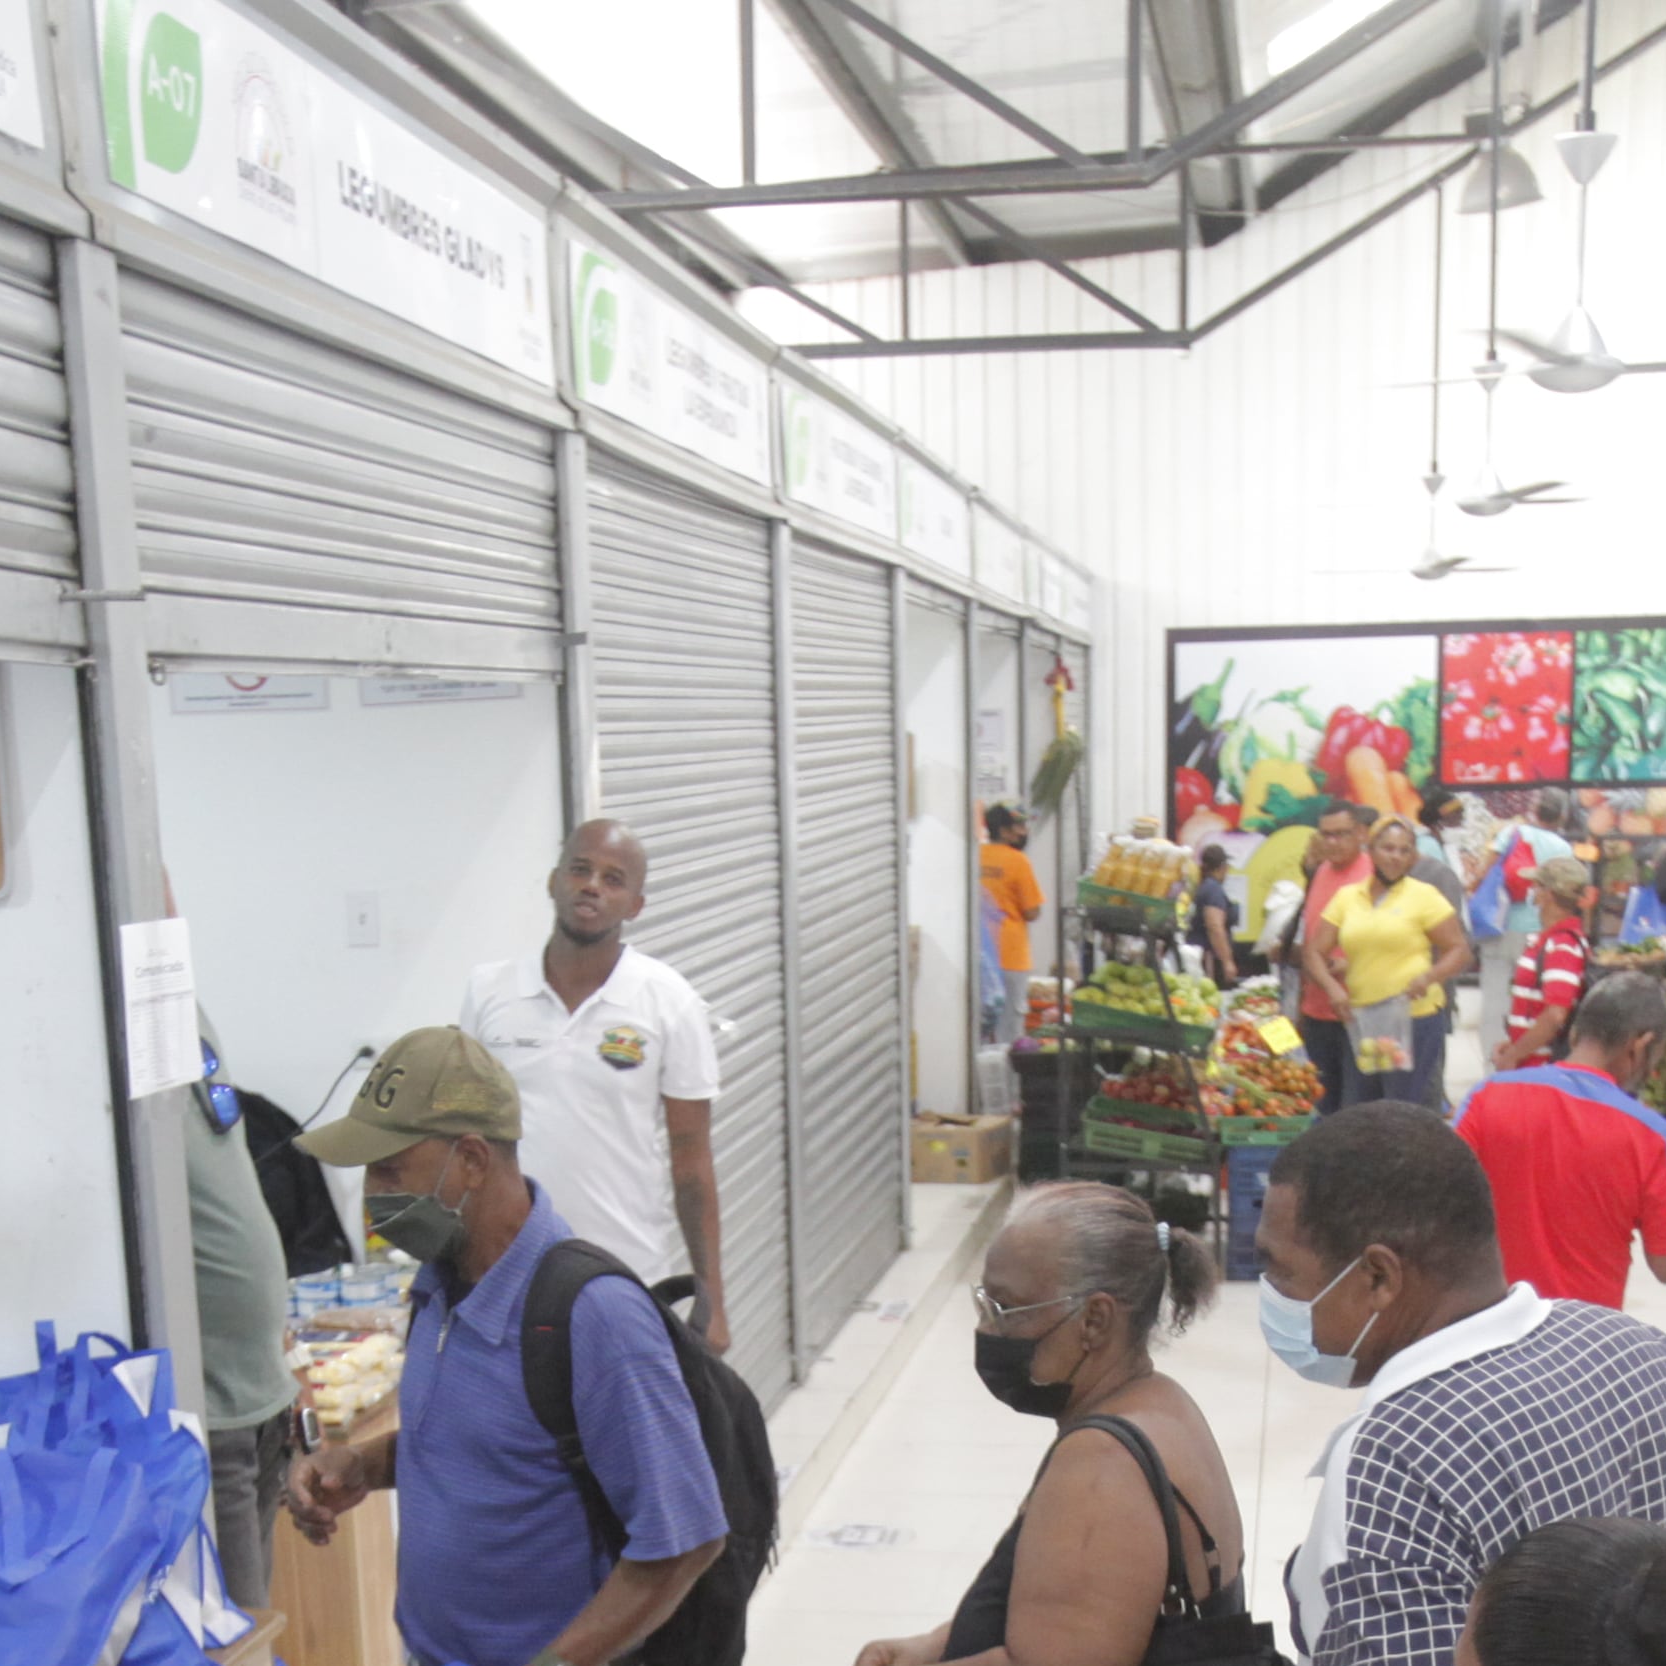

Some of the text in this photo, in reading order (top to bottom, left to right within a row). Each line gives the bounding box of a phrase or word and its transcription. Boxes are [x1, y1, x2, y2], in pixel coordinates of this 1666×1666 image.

[148, 54, 195, 118] A-07
[338, 159, 442, 255] LEGUMBRES
[444, 225, 505, 290] GLADYS
